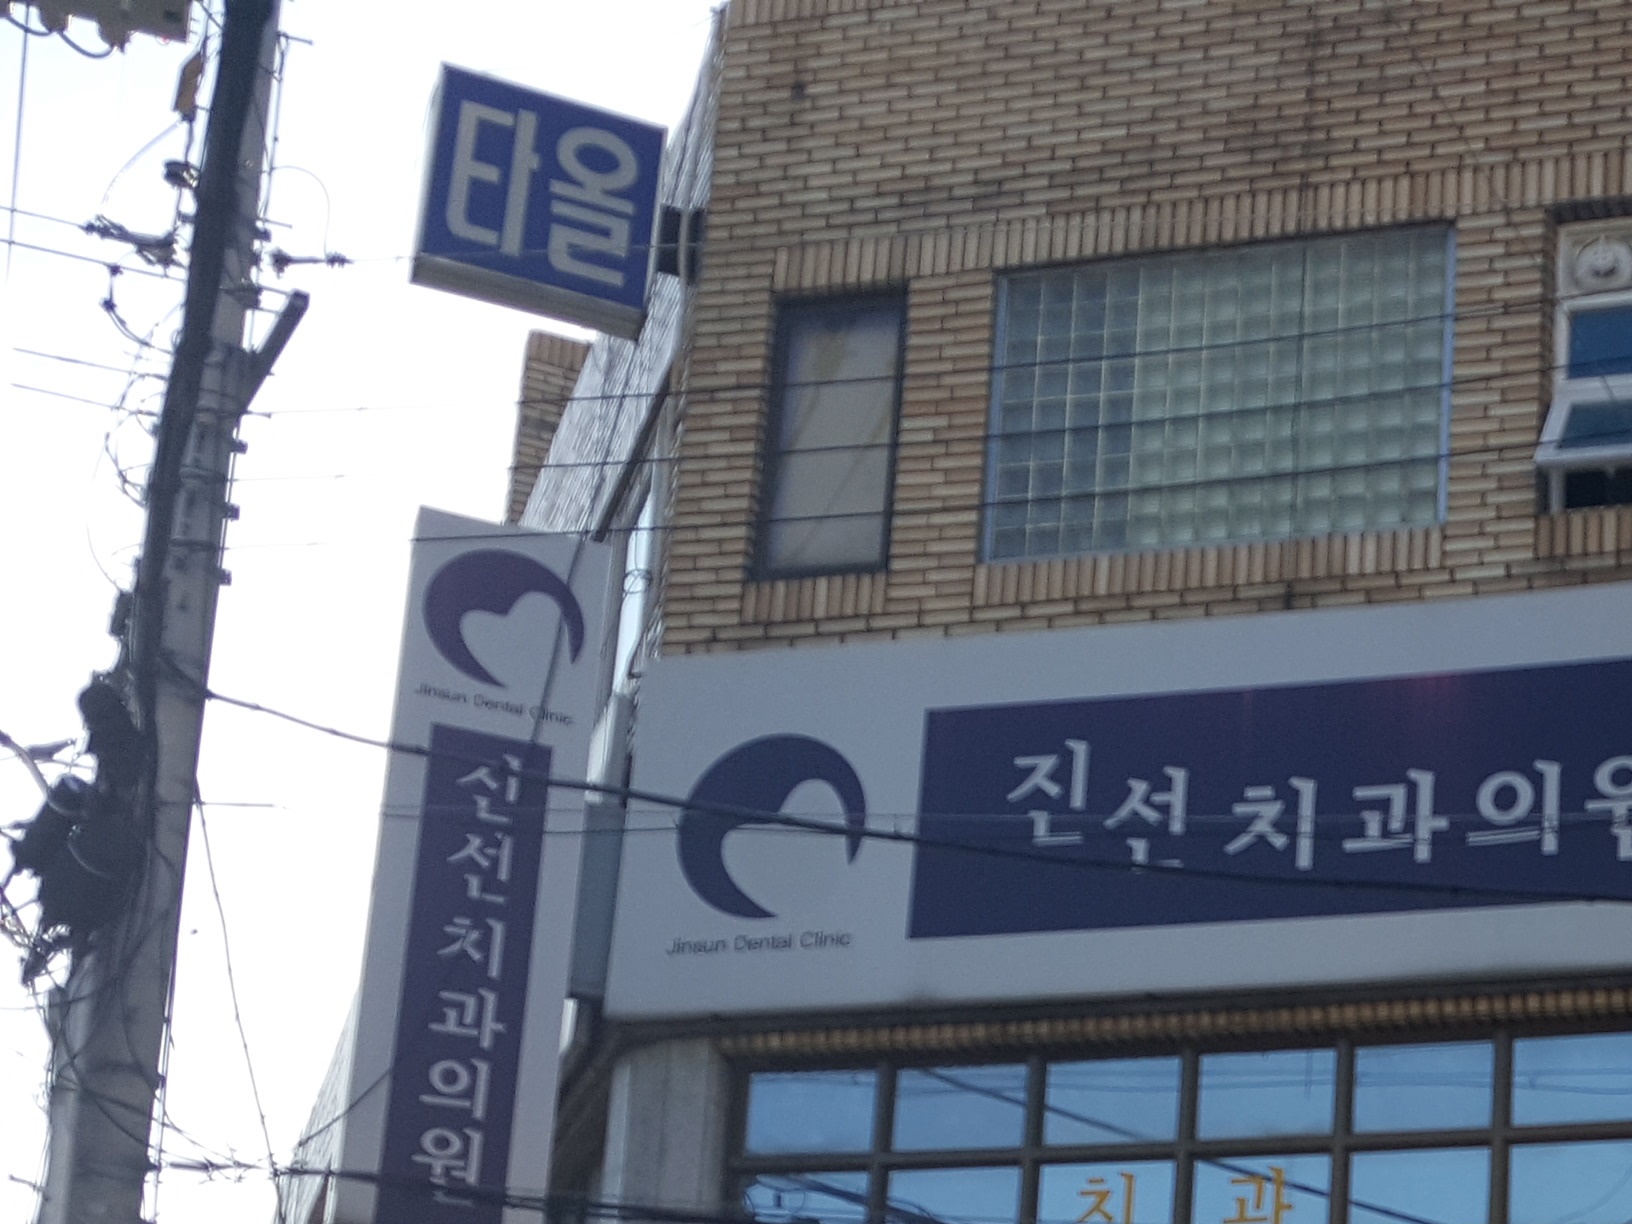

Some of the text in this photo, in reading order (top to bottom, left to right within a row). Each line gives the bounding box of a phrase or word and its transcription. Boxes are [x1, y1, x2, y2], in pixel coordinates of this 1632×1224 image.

[446, 100, 640, 287] 타올
[667, 931, 851, 957] Jinsun Dental Clinic
